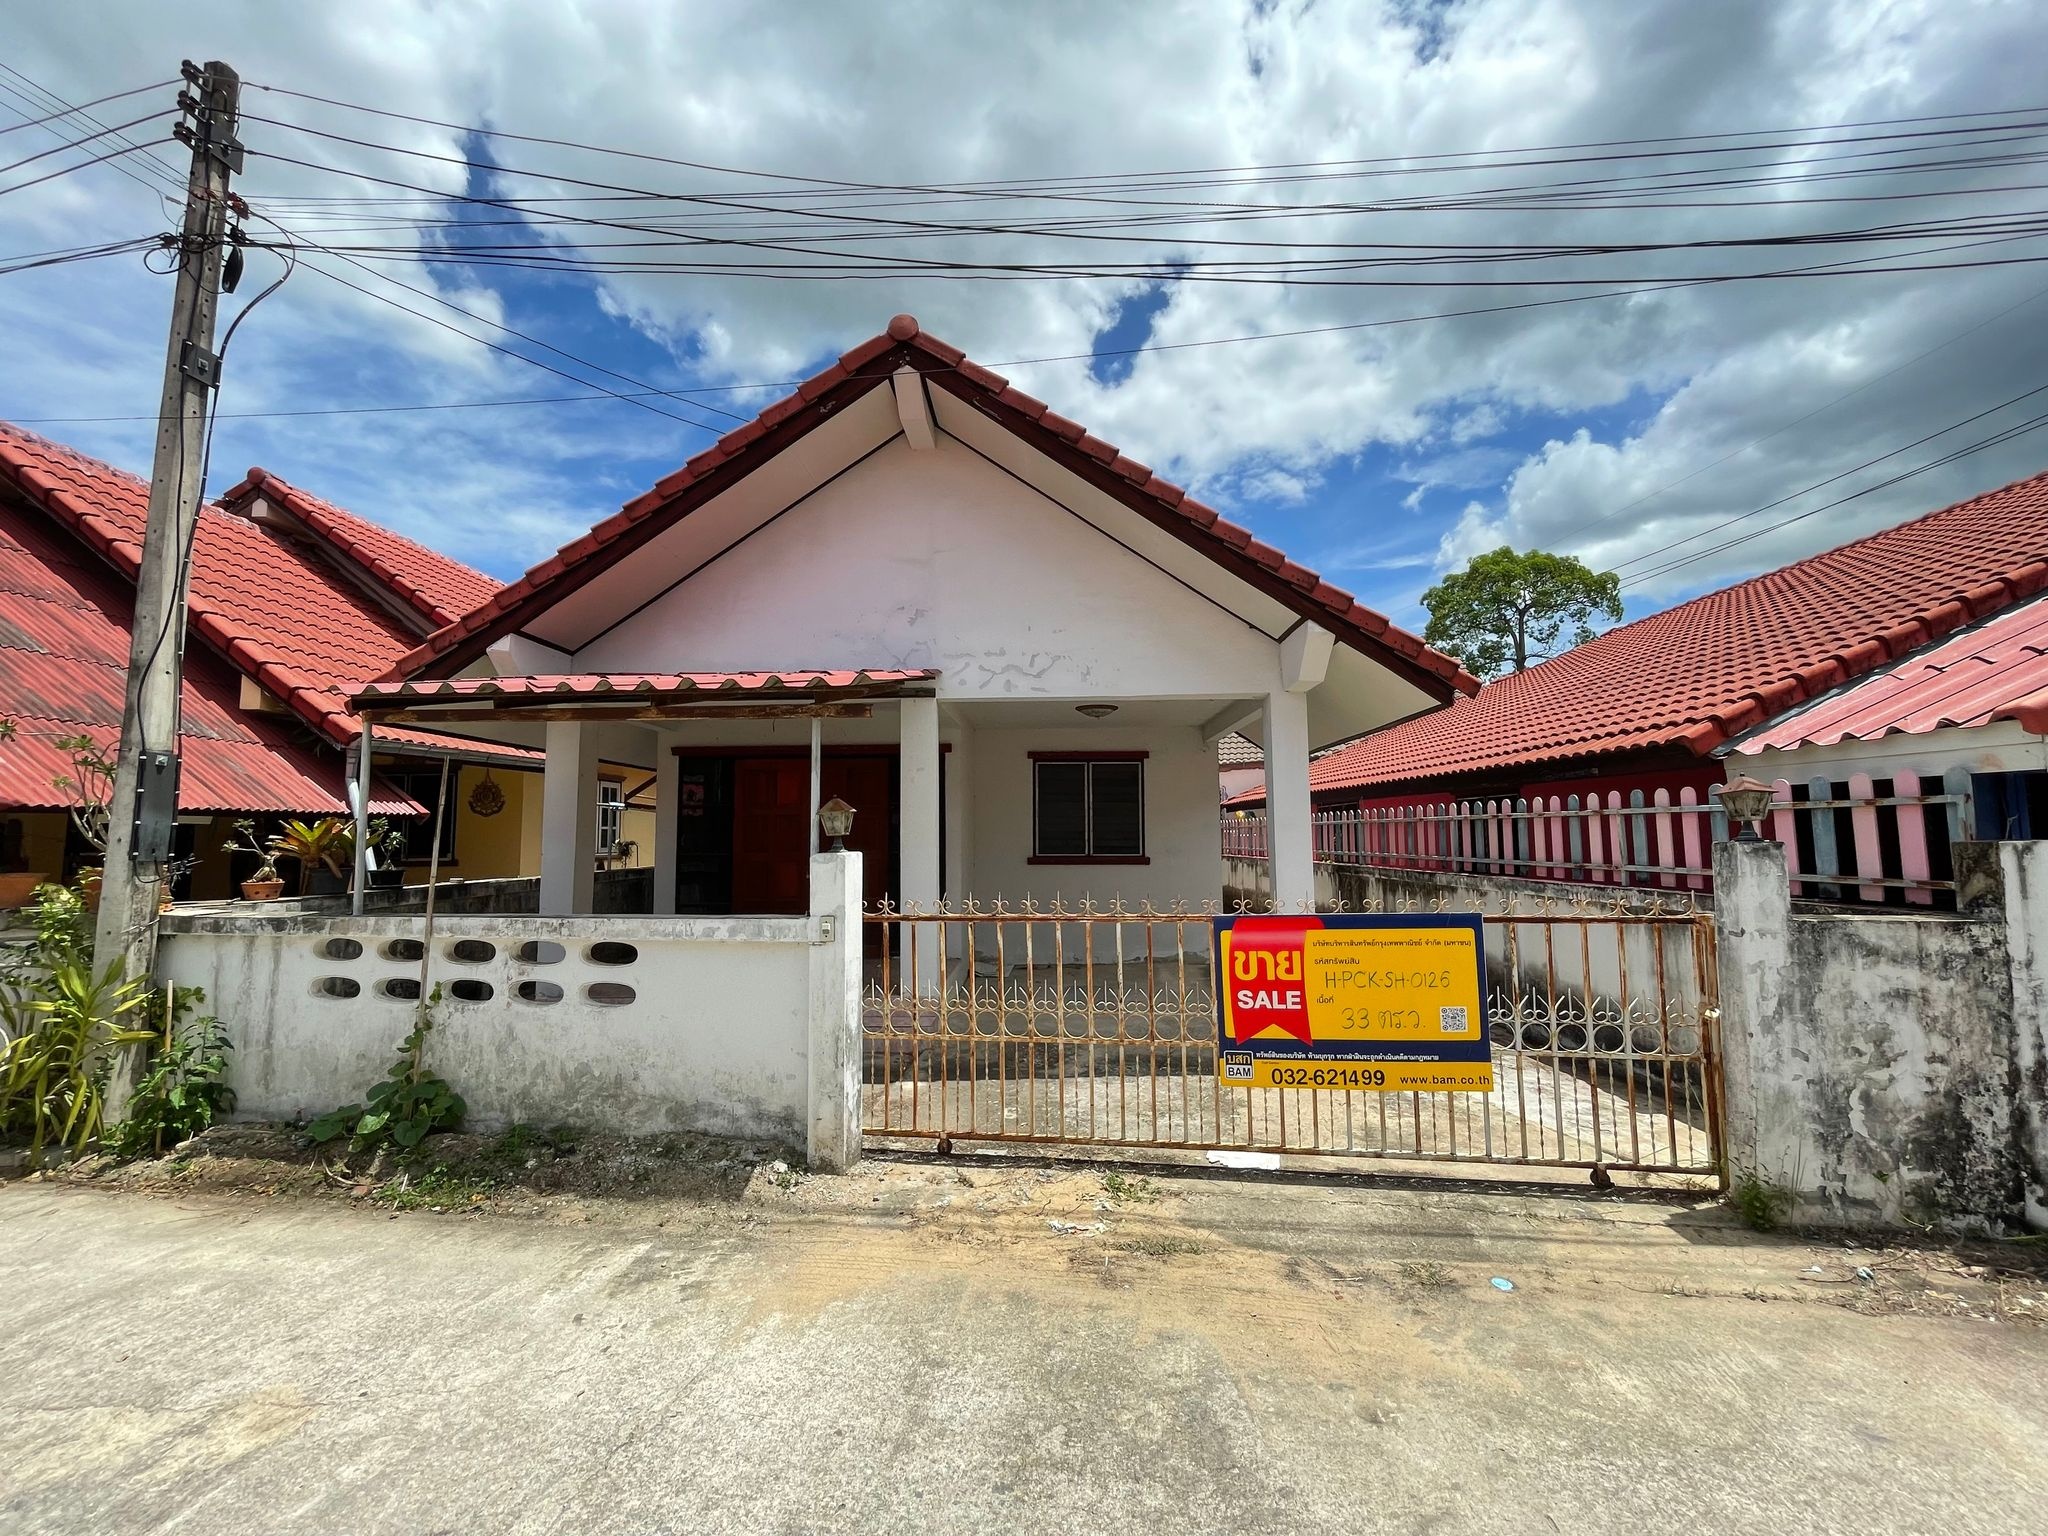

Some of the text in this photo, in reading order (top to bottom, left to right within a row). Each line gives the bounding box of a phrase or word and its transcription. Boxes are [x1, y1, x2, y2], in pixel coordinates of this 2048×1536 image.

[1234, 950, 1302, 981] ขาย
[1237, 989, 1302, 1010] SALE
[1341, 1007, 1370, 1029] 33
[1227, 1053, 1251, 1065] บสก
[1228, 1066, 1251, 1077] BAM
[1271, 1067, 1386, 1087] 032-621499
[1399, 1075, 1490, 1085] www.bam.co.th
